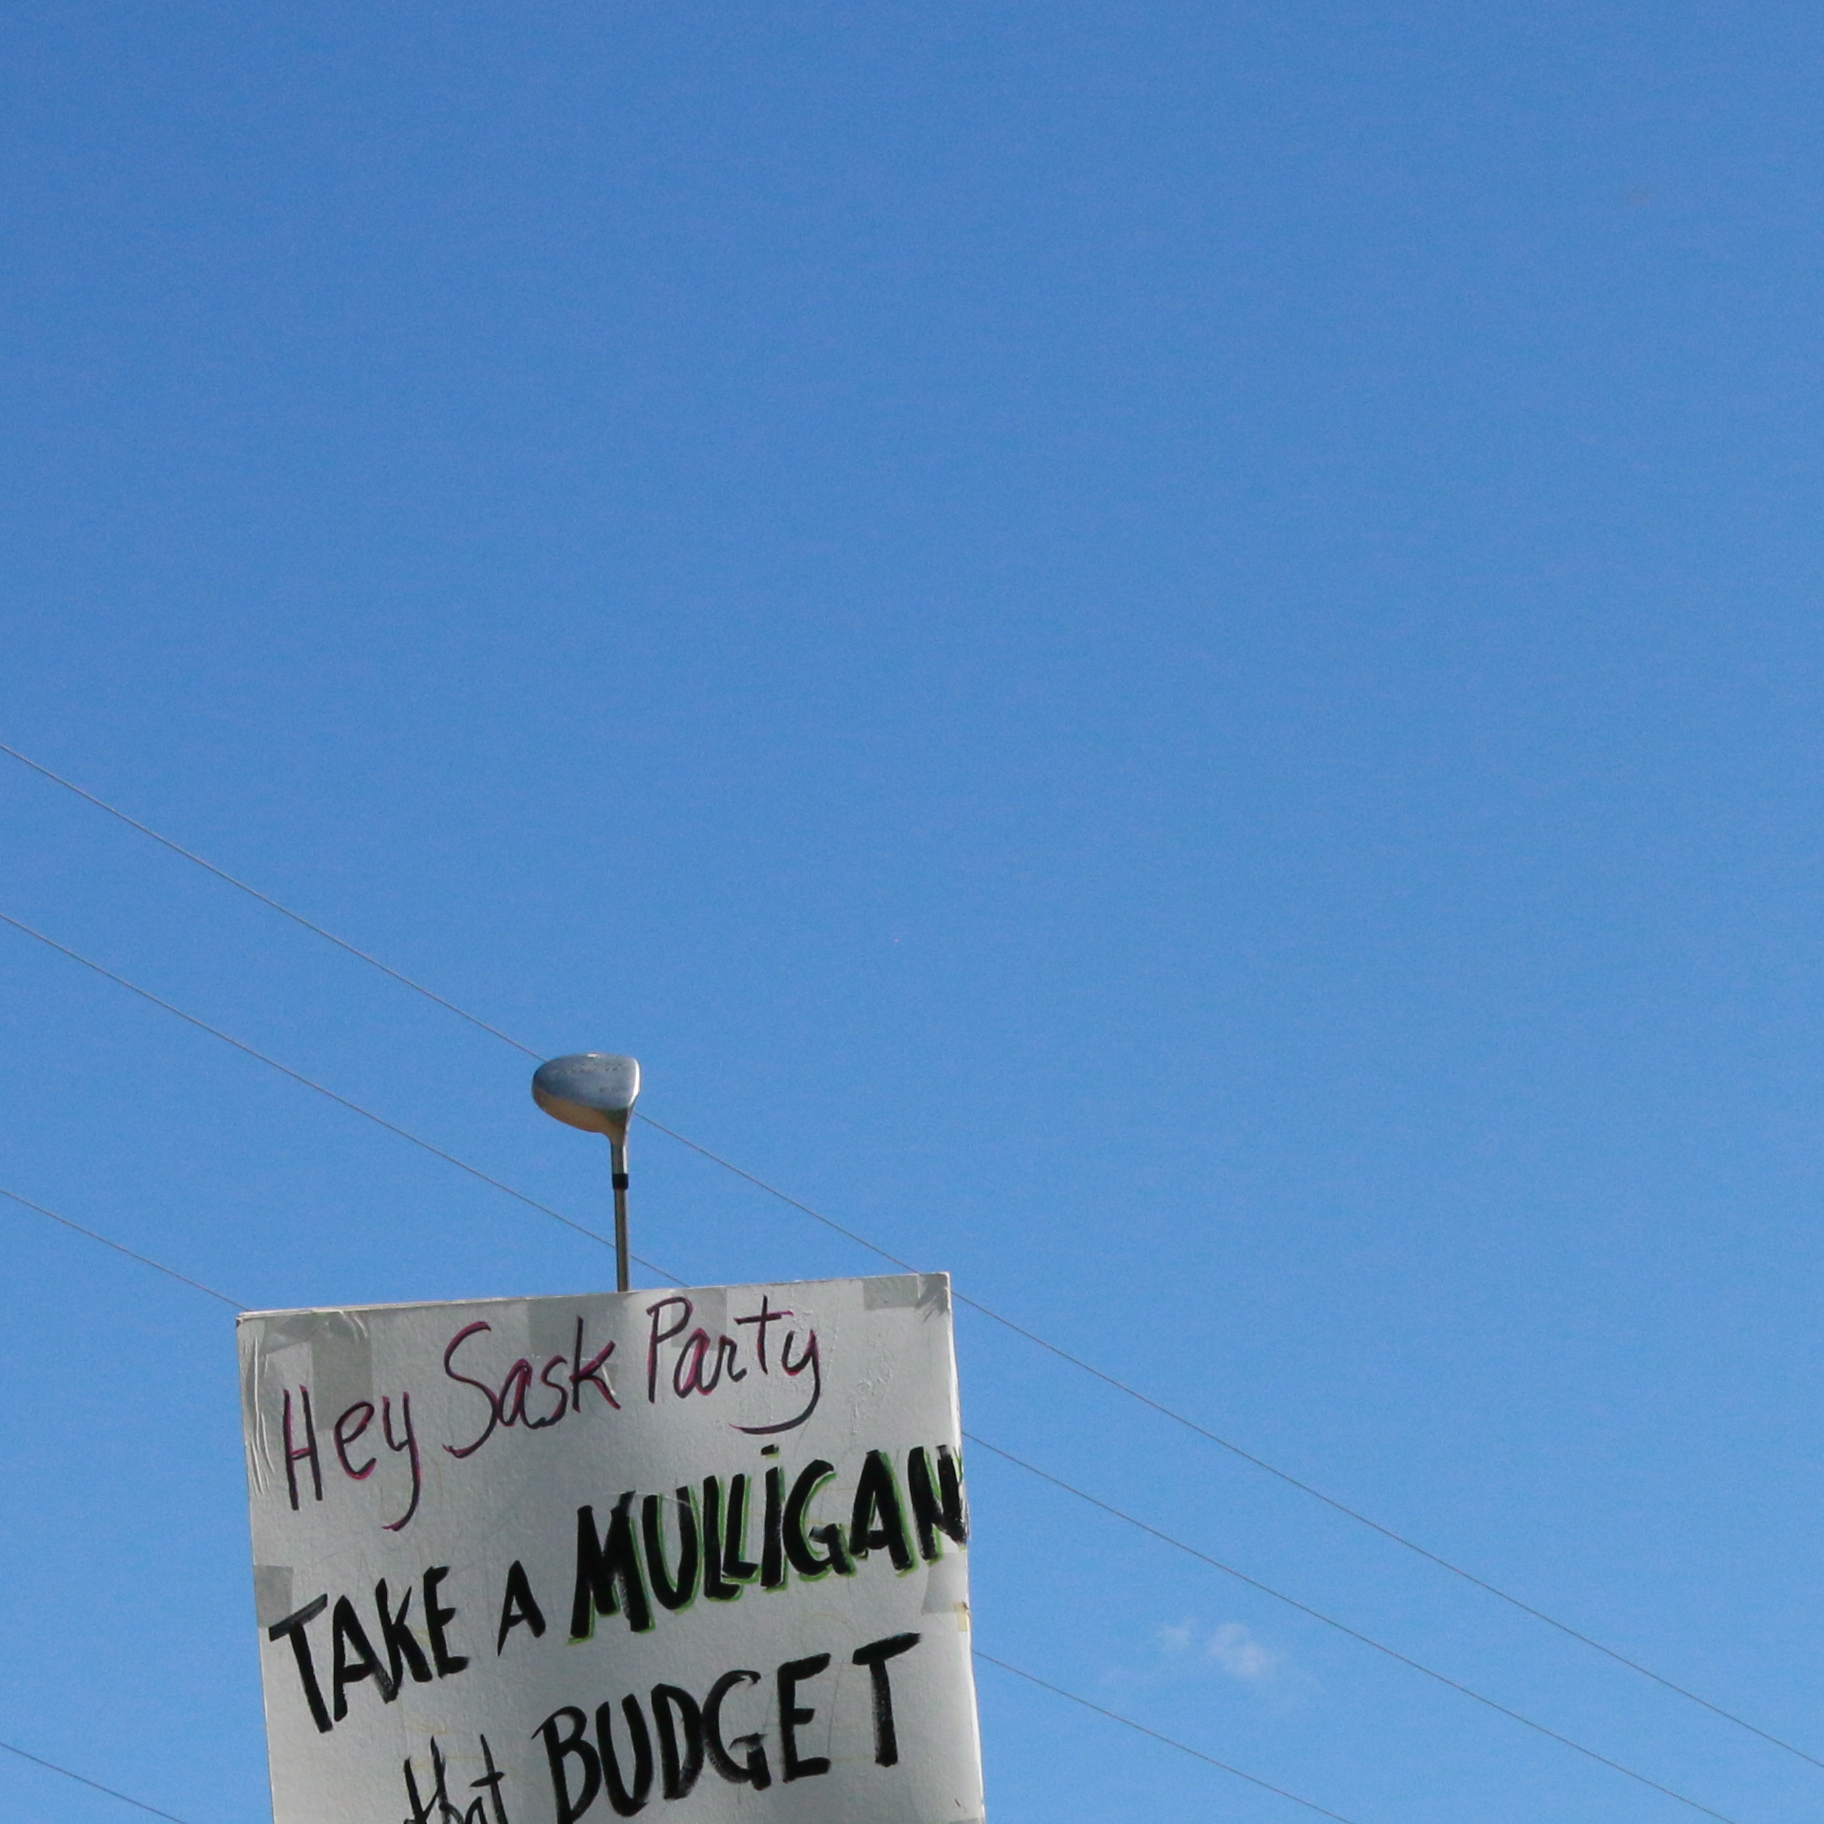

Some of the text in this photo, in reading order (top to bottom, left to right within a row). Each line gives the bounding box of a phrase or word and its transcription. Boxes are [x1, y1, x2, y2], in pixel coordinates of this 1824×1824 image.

[283, 1294, 824, 1531] Hey Sask Party
[268, 1444, 968, 1733] TAKE A MULLIGAN
